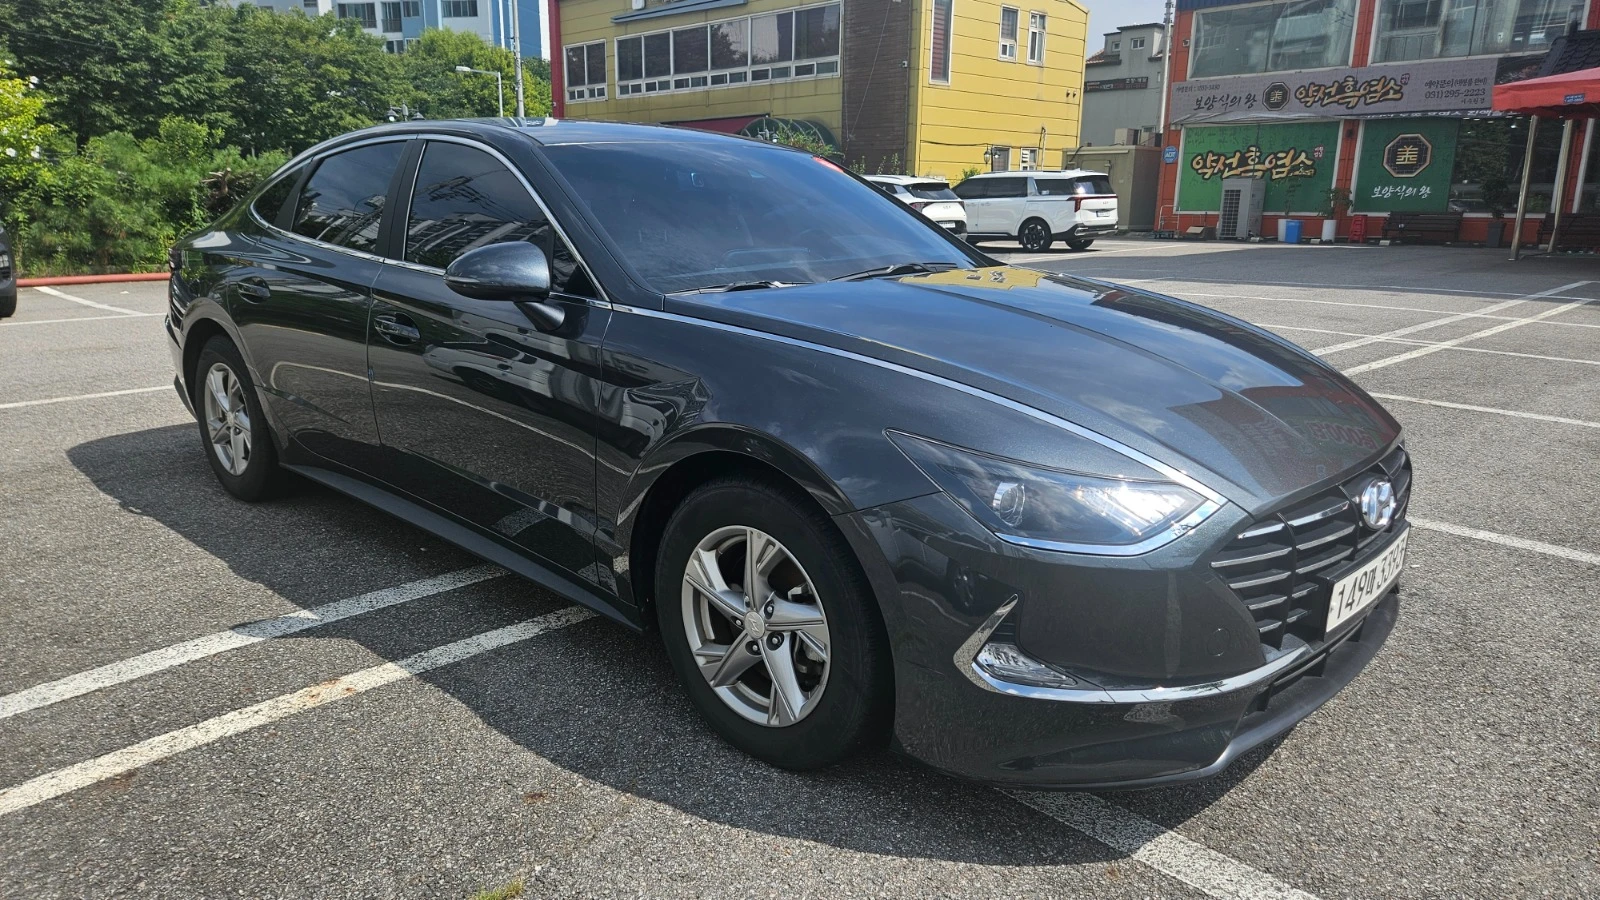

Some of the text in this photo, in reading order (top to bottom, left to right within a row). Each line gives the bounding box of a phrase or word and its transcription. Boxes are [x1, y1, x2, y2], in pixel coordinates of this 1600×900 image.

[1193, 94, 1241, 111] 보양식의
[1244, 93, 1257, 109] 왕
[1295, 75, 1403, 108] 약선흑염소
[1191, 145, 1315, 180] 약선흑염소
[1371, 185, 1432, 200] 보양식의 왕
